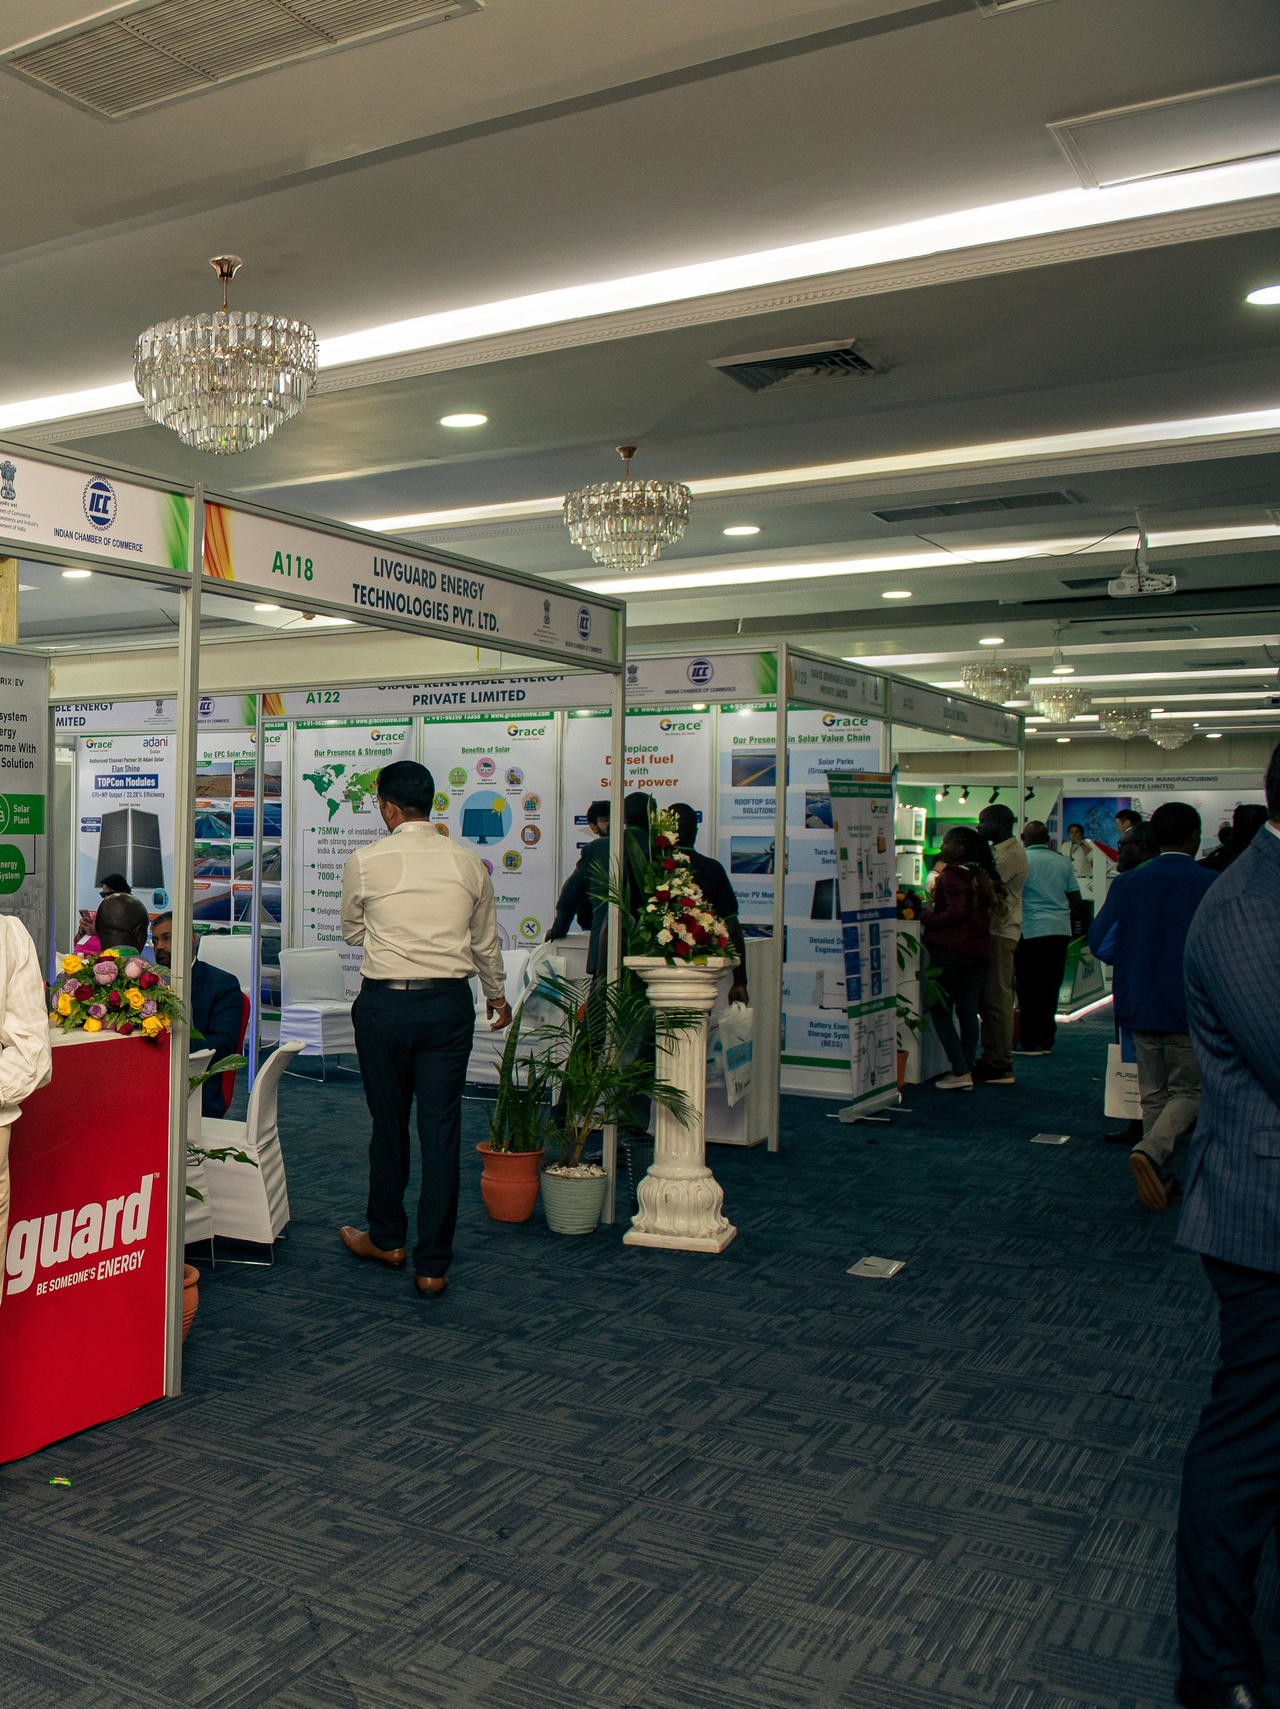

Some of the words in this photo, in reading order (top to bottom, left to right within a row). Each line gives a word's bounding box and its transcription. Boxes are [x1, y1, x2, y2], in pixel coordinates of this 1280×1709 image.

[89, 493, 111, 514] ICC
[54, 528, 73, 539] INDIAN
[74, 532, 102, 545] CHAMBER
[104, 537, 111, 546] OF
[112, 539, 143, 552] COMMERCE
[272, 551, 313, 582] A118
[374, 556, 437, 589] LIVGUARD
[441, 574, 485, 600] ENERGY
[353, 583, 449, 622] TECHNOLOGIES
[453, 605, 474, 628] PVT.
[478, 611, 499, 633] LTD.
[691, 667, 708, 678] ICC
[15, 678, 24, 686] EV
[306, 691, 340, 704] A122
[413, 692, 466, 706] PRIVATE
[471, 690, 526, 703] LIMITED
[659, 718, 702, 731] Grace
[822, 713, 868, 727] Grace
[370, 730, 405, 741] Grace
[507, 724, 545, 736] Grace
[86, 738, 112, 749] Grace
[143, 736, 168, 748] adani
[733, 736, 746, 744] Our
[798, 735, 818, 743] Solar
[822, 734, 844, 742] Value
[847, 734, 871, 742] Chain
[18, 742, 36, 753] With
[314, 749, 325, 757] Our
[327, 748, 356, 757] Presence
[358, 748, 362, 756] &
[365, 748, 392, 757] Strength
[1, 757, 34, 769] Solution
[649, 754, 674, 765] fuel
[629, 767, 649, 775] with
[97, 778, 124, 787] TOPCon
[126, 777, 156, 787] Modules
[638, 778, 679, 789] power
[13, 804, 30, 813] Solar
[13, 816, 30, 825] Plant
[809, 937, 835, 945] Detailed
[810, 1021, 832, 1030] Battery
[808, 1030, 832, 1039] Storage
[821, 1040, 843, 1048] (BESS)
[6, 1173, 153, 1296] guard
[36, 1283, 47, 1296] BE
[49, 1267, 95, 1292] SOMEONE'S
[97, 1249, 145, 1281] ENERGY
